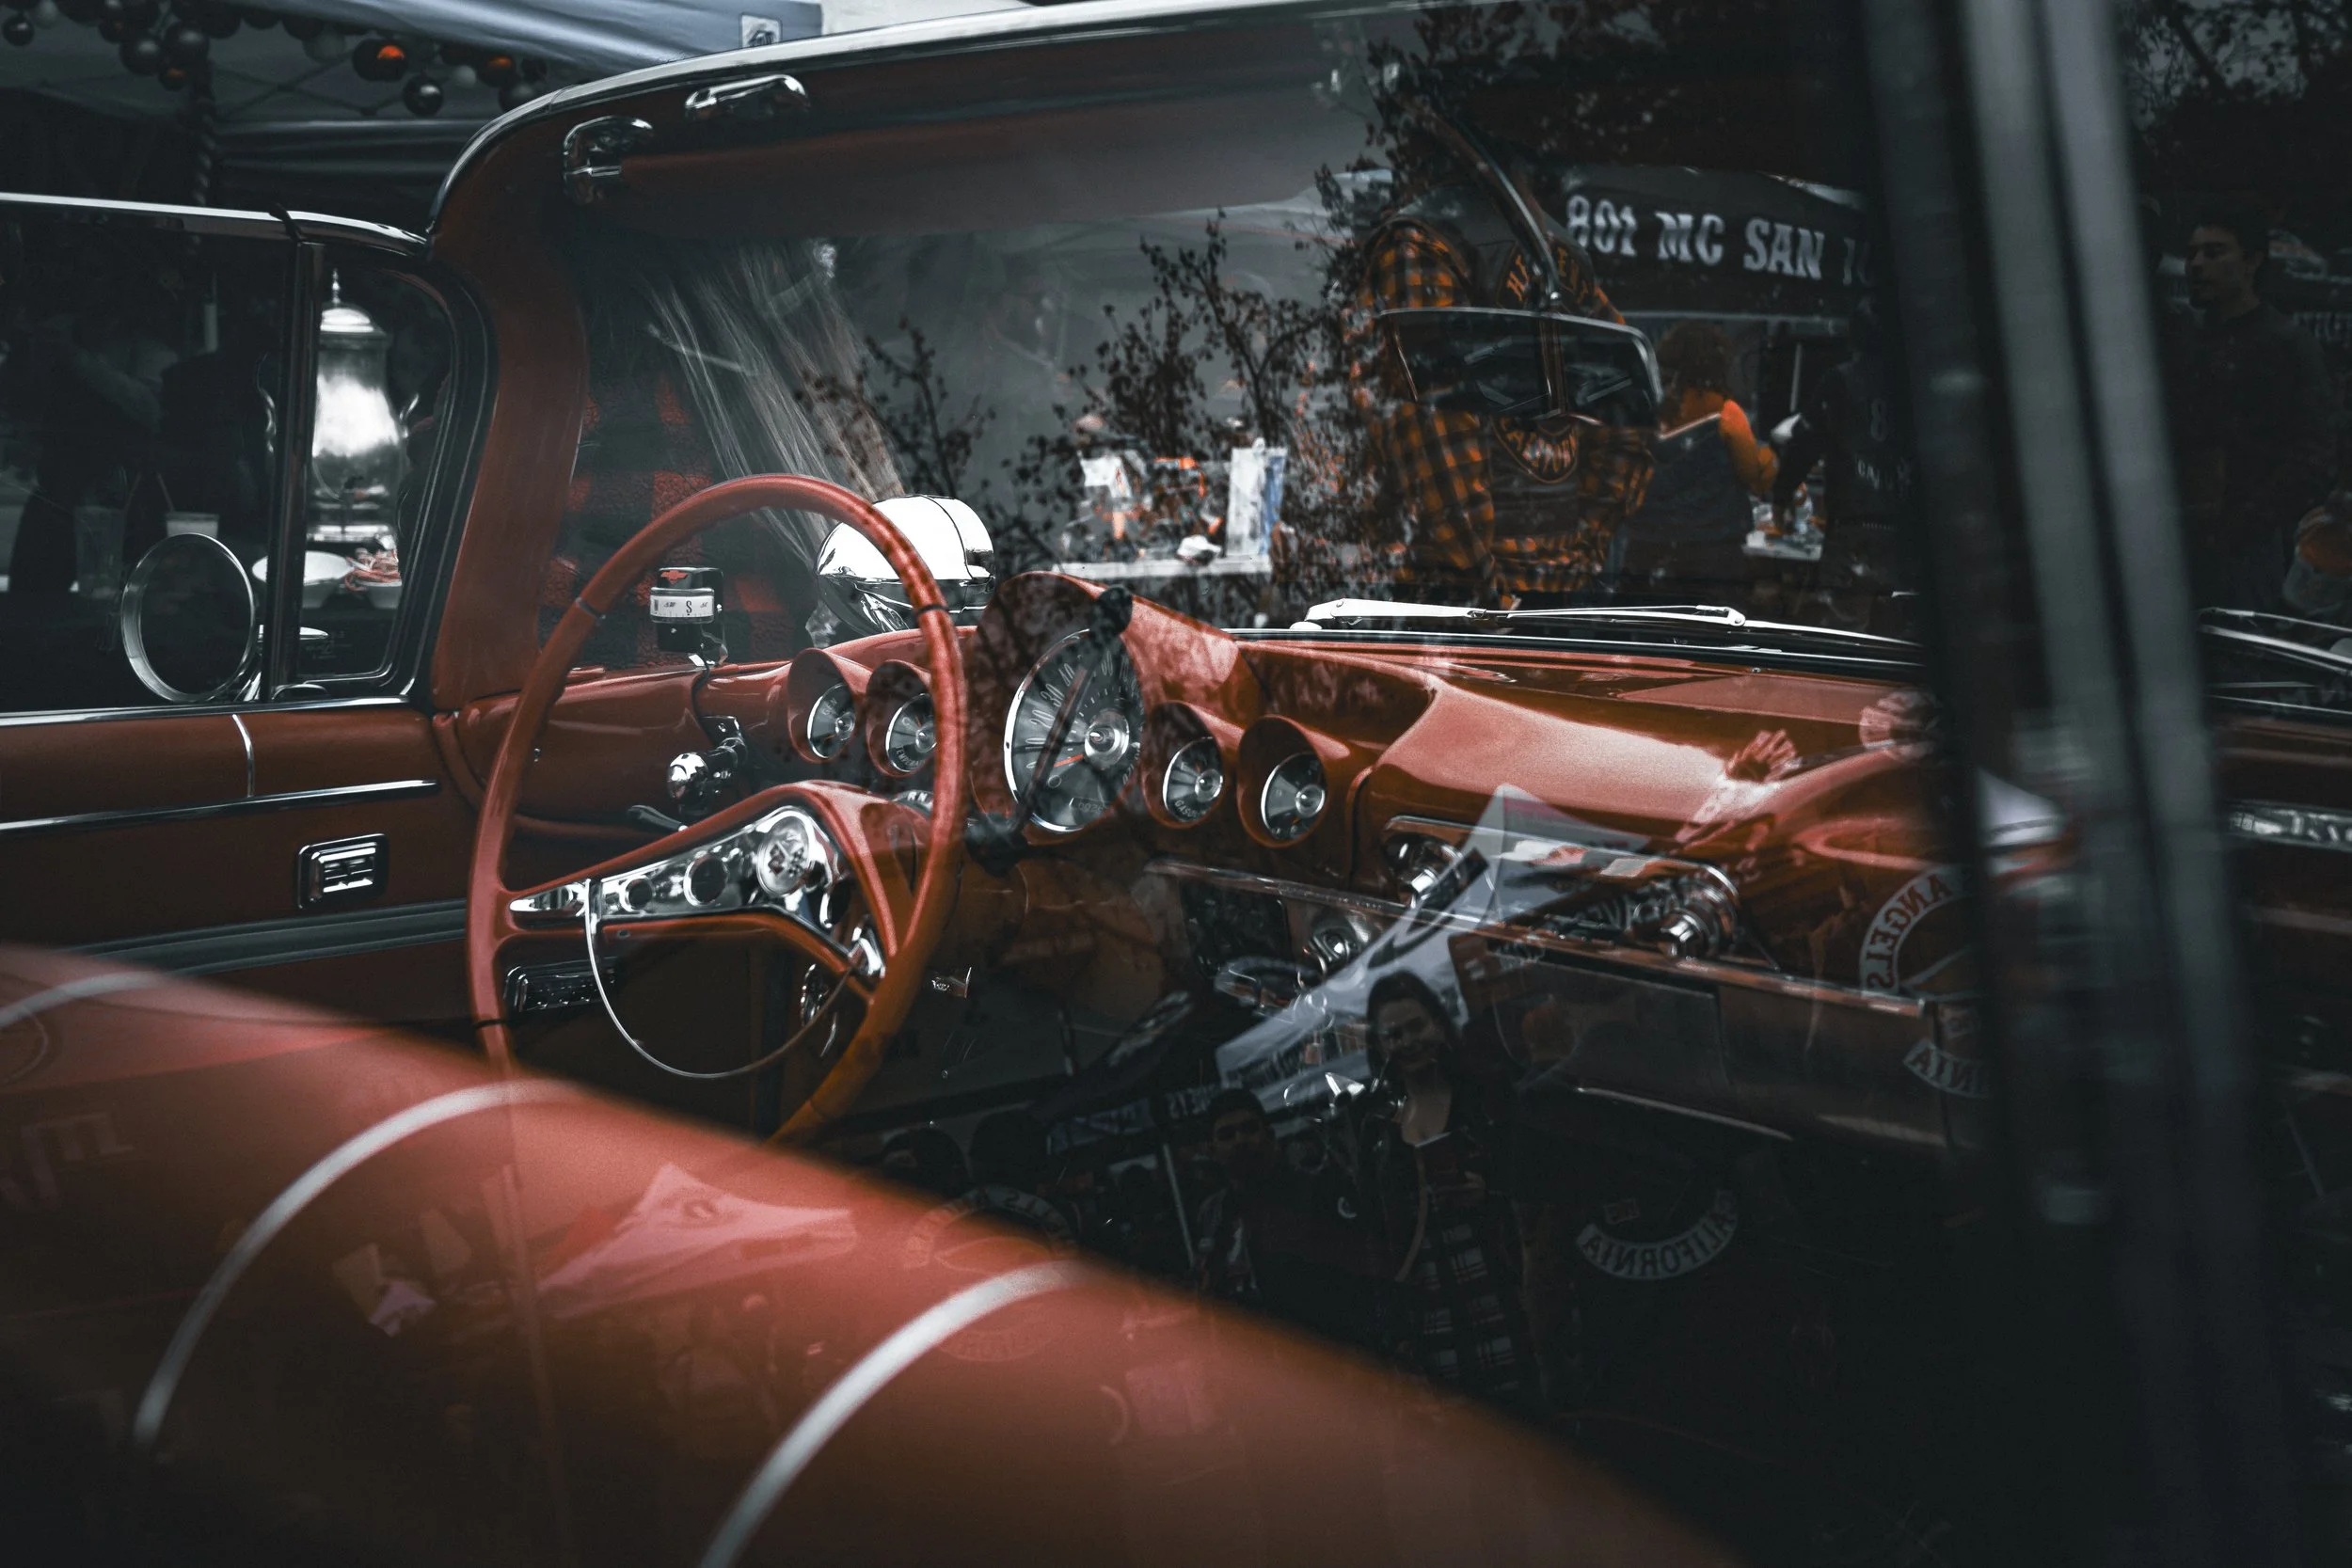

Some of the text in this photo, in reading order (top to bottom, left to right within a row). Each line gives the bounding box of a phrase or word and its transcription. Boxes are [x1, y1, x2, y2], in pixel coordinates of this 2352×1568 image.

[1655, 211, 1725, 266] MC
[1743, 216, 1826, 280] SAN
[1041, 683, 1066, 707] 30
[1030, 708, 1056, 730] 20
